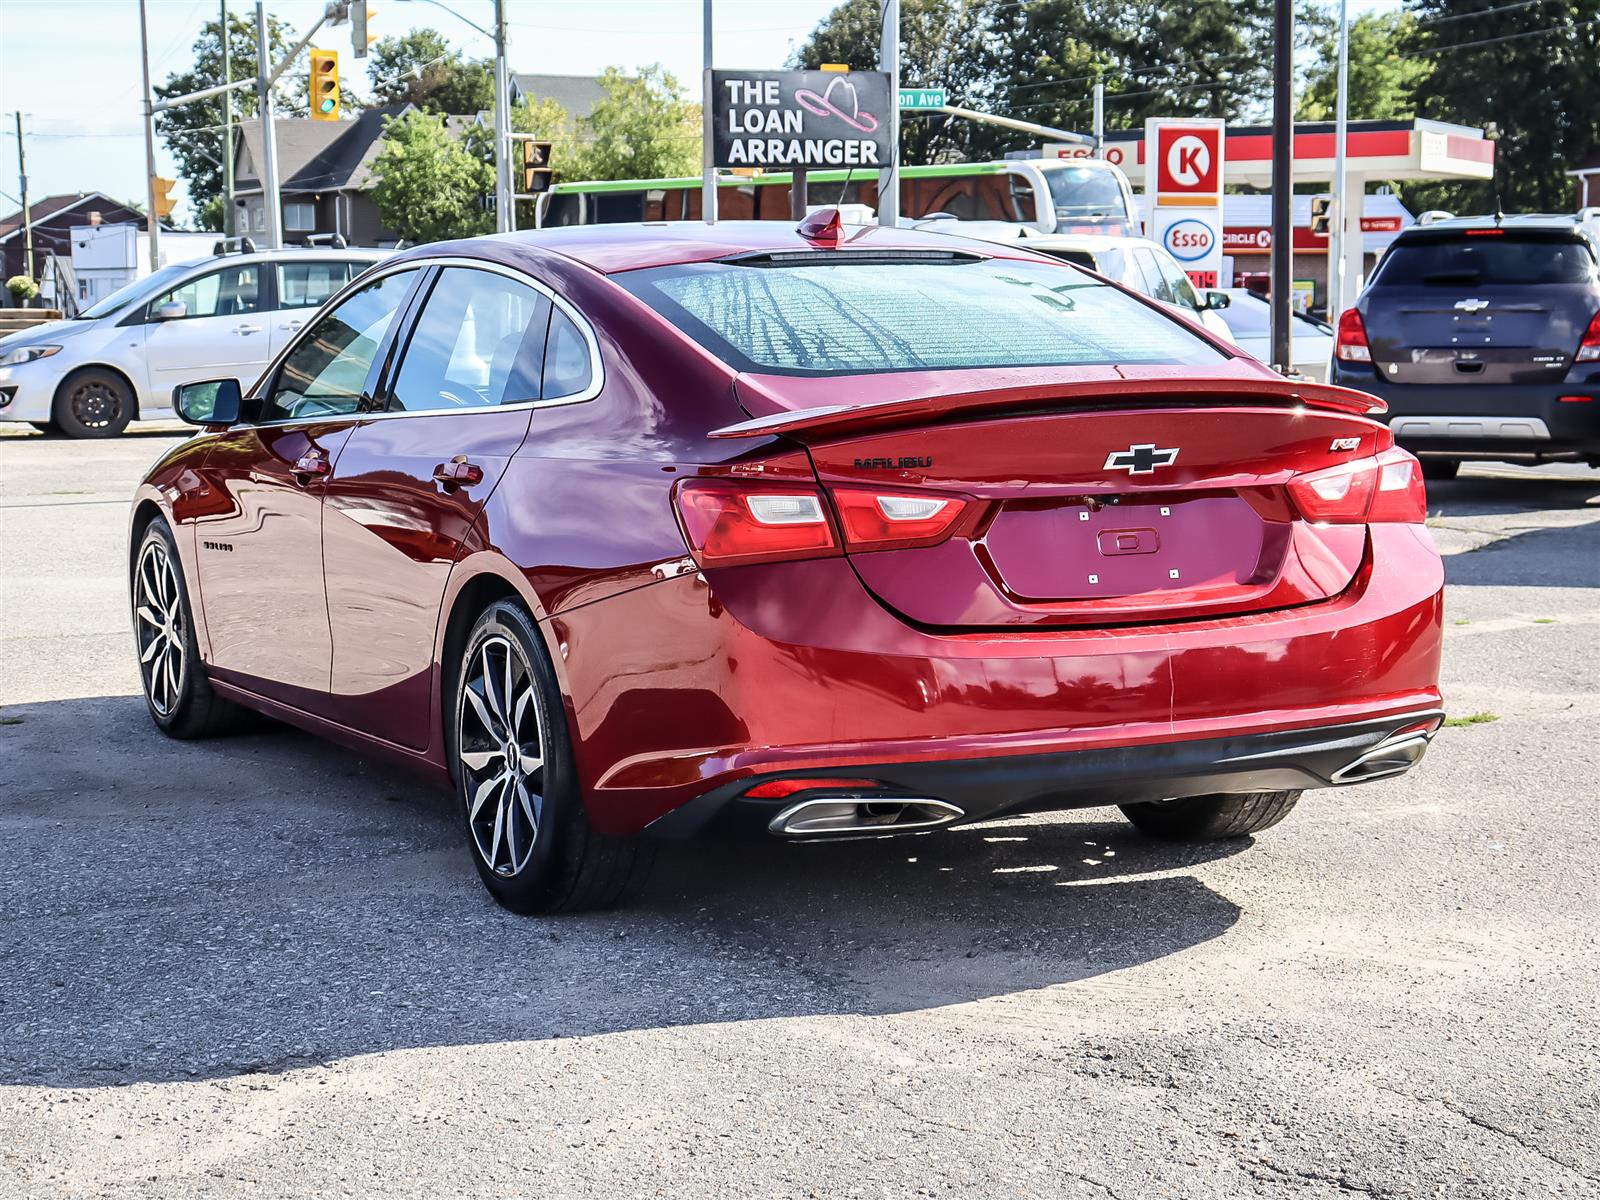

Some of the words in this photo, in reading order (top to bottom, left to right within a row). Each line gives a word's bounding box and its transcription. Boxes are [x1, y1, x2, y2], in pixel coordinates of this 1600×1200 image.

[725, 80, 780, 105] THE
[918, 92, 942, 105] Ave
[729, 108, 802, 133] LOAN
[728, 139, 879, 164] ARRANGER
[854, 456, 932, 470] MALIBU
